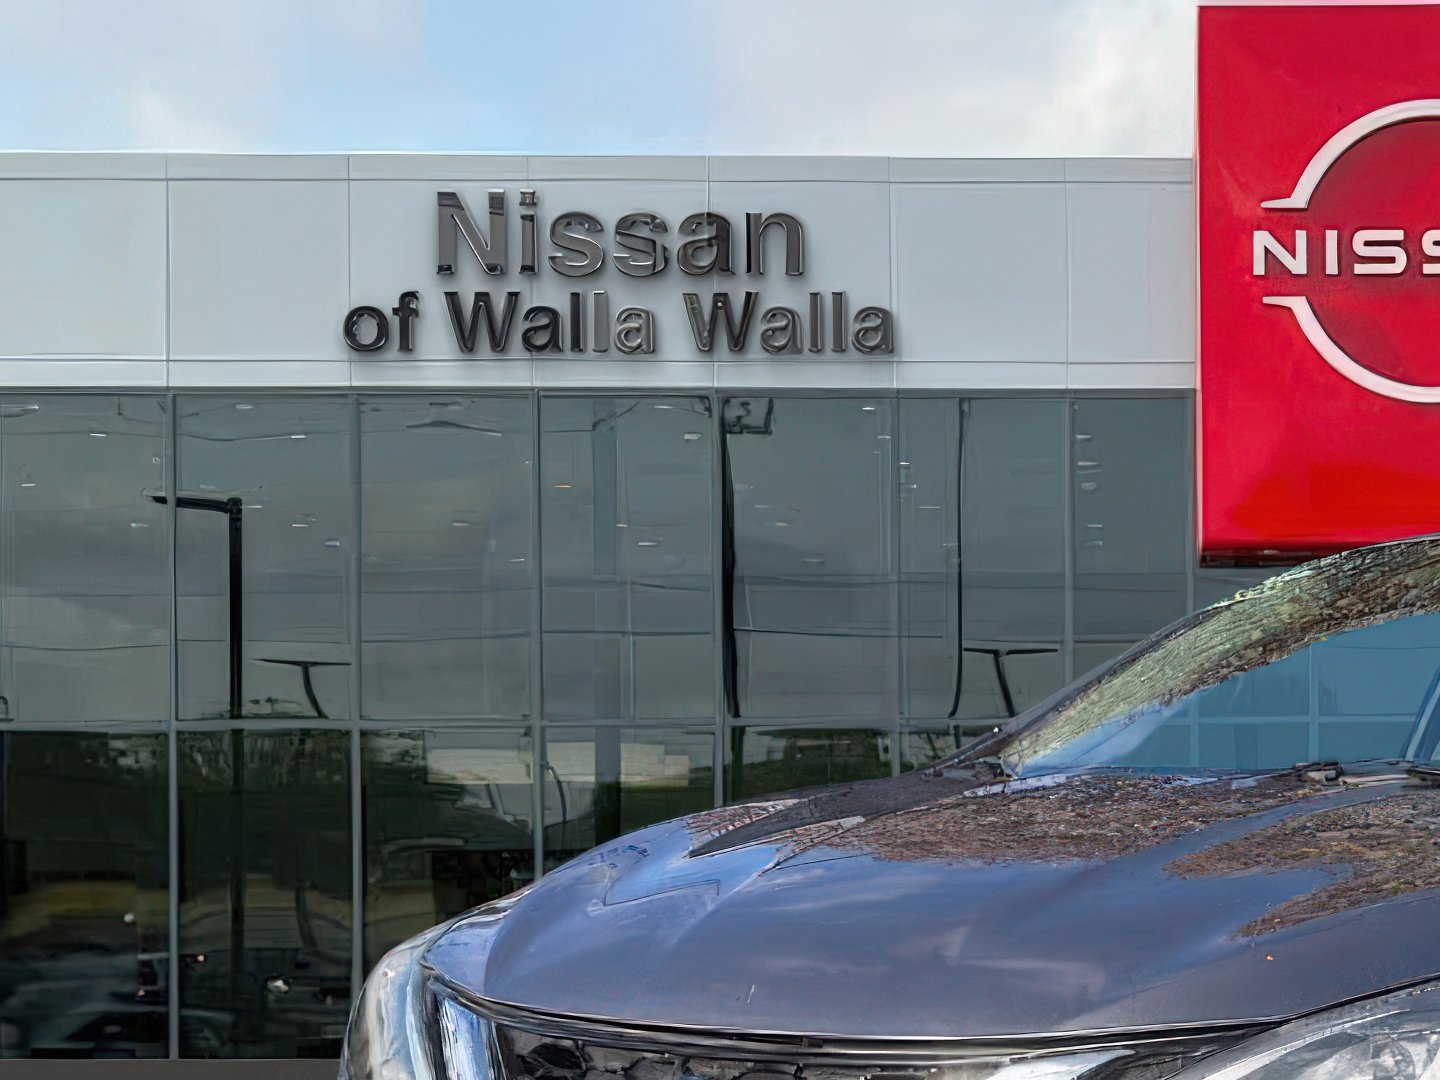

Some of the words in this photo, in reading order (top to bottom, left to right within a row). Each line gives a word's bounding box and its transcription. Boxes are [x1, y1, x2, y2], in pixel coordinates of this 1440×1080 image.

[436, 187, 805, 277] Nissan
[342, 290, 420, 353] of
[444, 290, 656, 355] Walla
[682, 290, 895, 355] Walla
